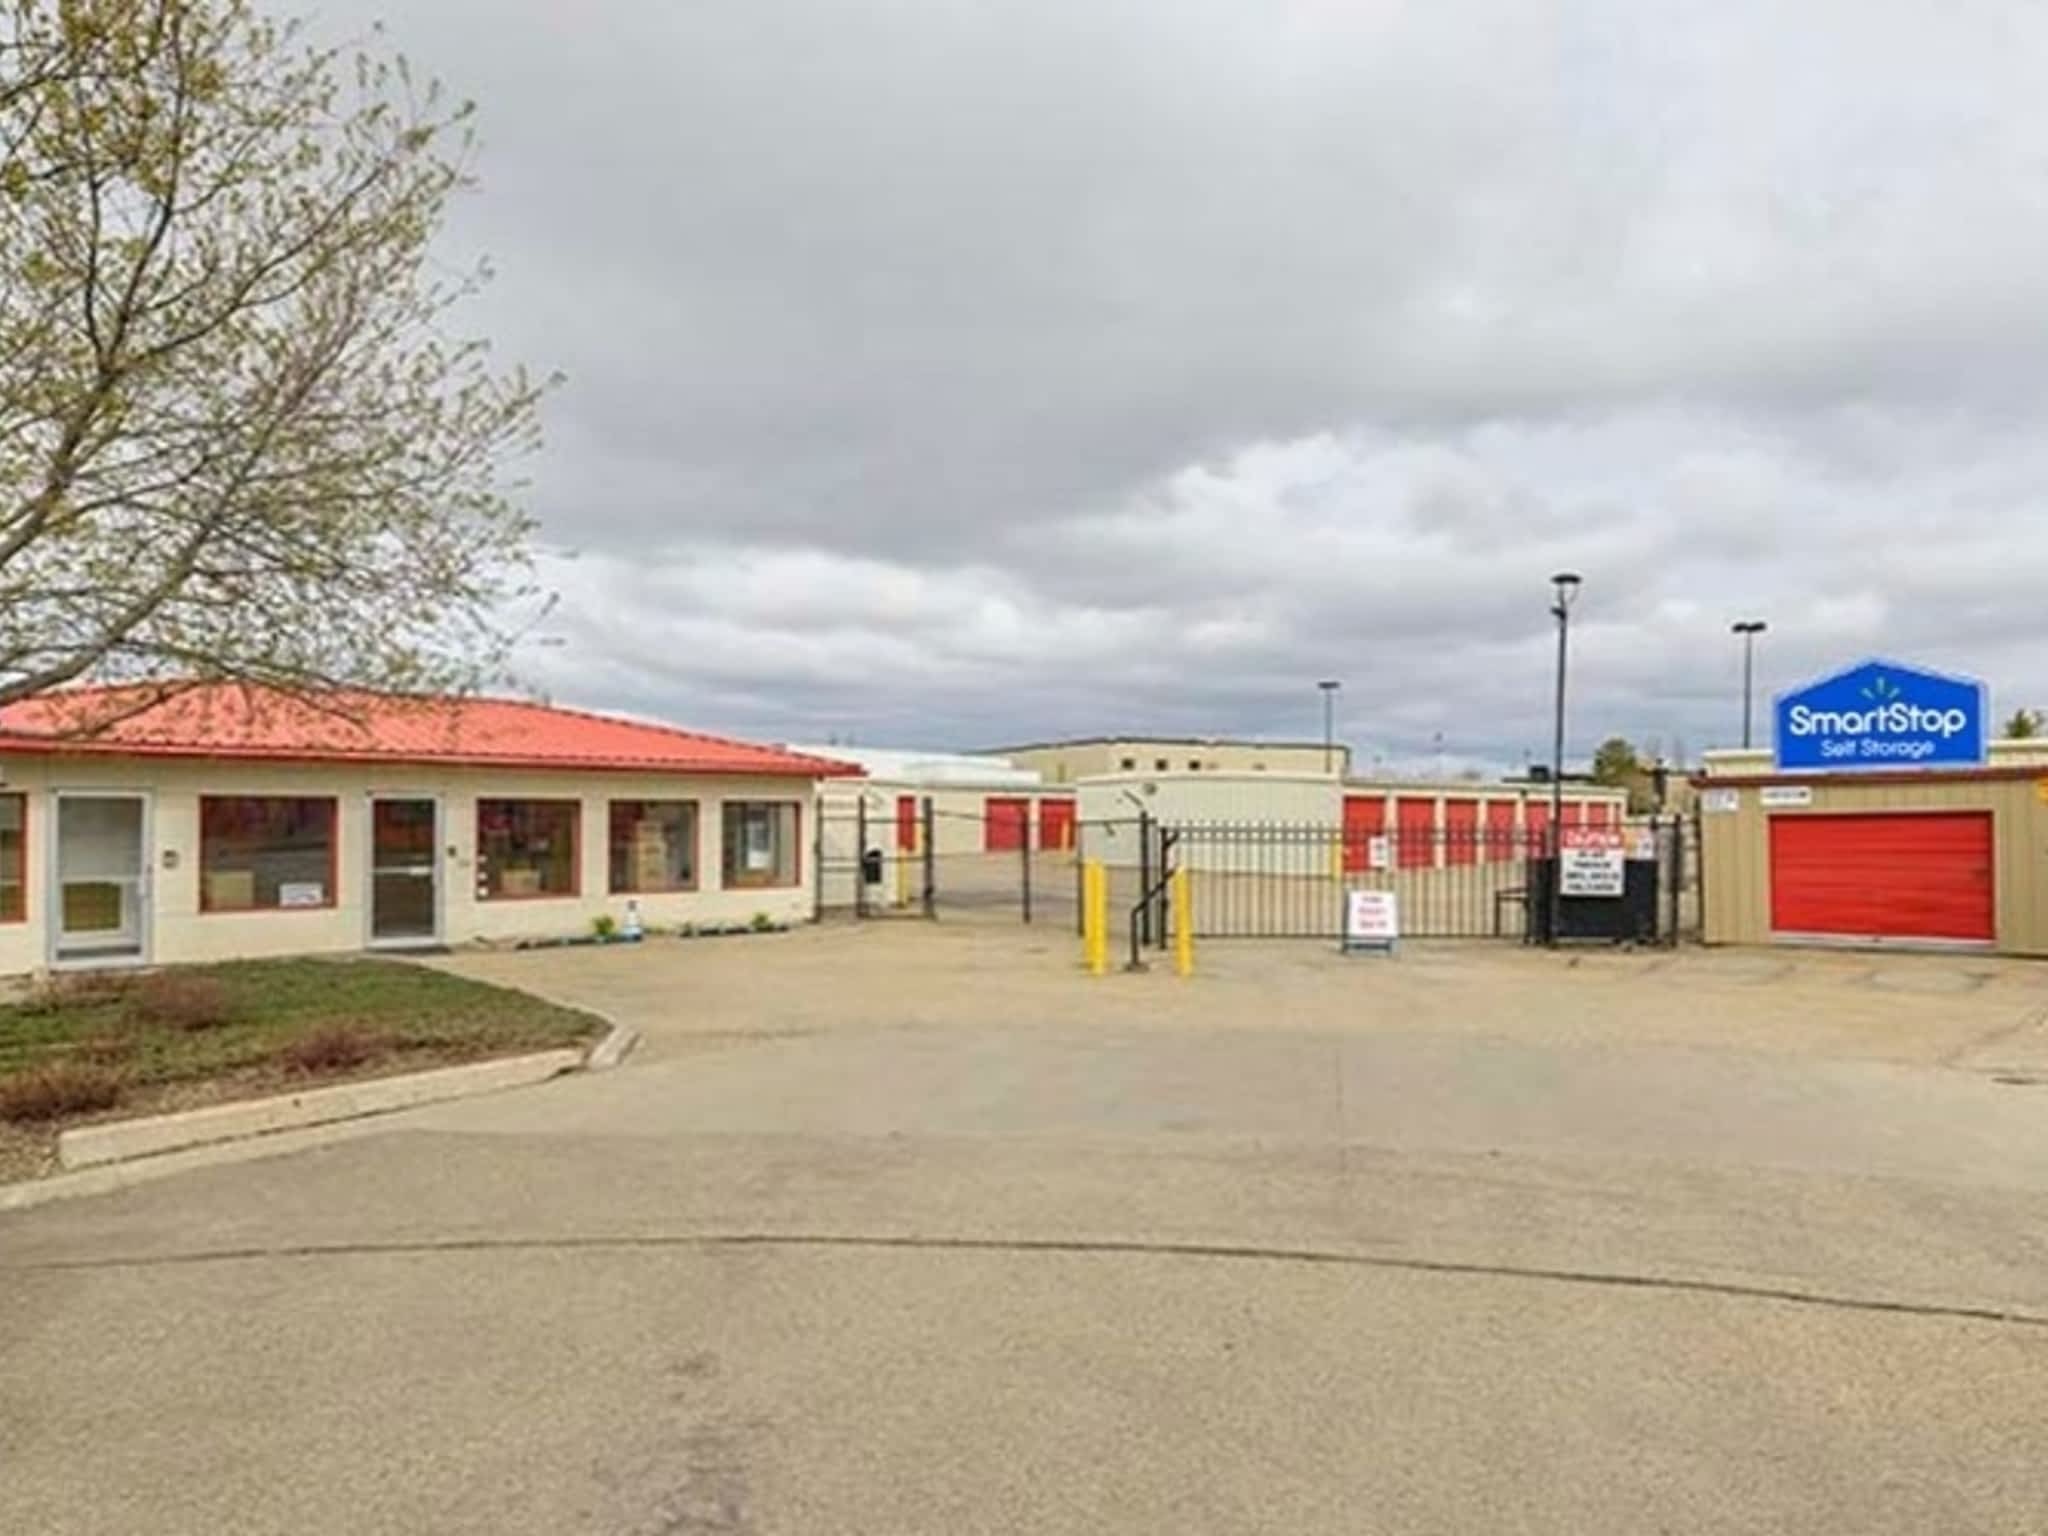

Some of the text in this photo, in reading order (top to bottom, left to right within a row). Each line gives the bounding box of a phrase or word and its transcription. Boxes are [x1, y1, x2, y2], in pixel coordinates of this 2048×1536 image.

[1789, 702, 1967, 738] SmartStop
[1821, 738, 1936, 759] Self Storage
